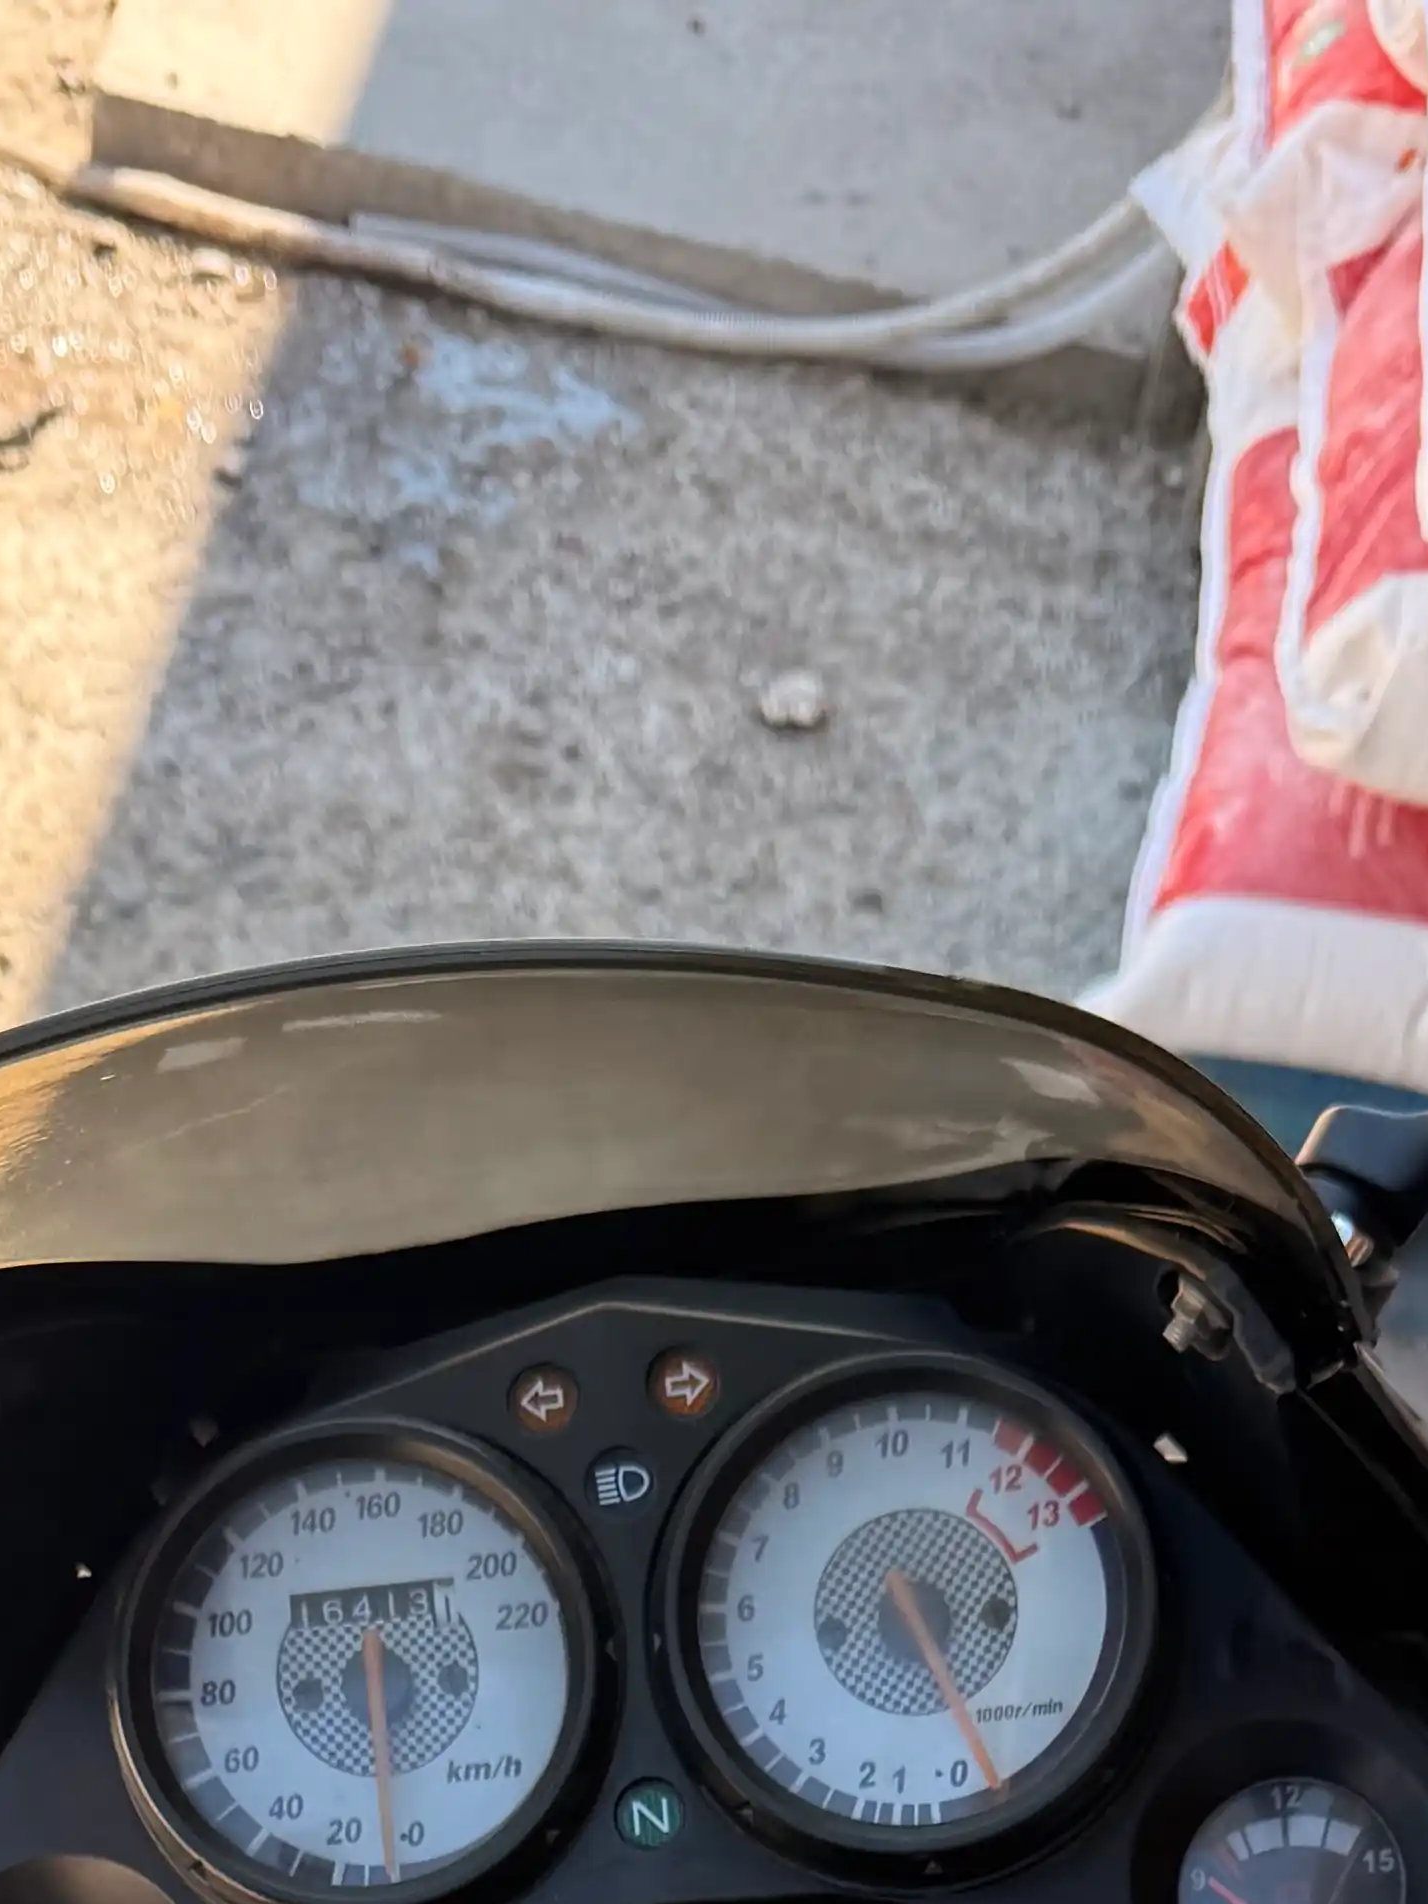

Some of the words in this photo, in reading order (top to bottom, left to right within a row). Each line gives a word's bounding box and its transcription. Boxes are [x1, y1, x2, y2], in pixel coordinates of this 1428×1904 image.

[875, 1431, 908, 1457] 10
[942, 1441, 971, 1467] 11
[827, 1451, 843, 1476] 9
[990, 1465, 1021, 1492] 12
[356, 1493, 401, 1520] 160
[783, 1484, 800, 1509] 8
[291, 1508, 336, 1535] 140
[418, 1510, 464, 1538] 180
[1027, 1501, 1060, 1529] 13
[753, 1536, 769, 1562] 7
[240, 1551, 283, 1579] 120
[467, 1552, 517, 1580] 200
[497, 1604, 548, 1631] 220
[738, 1596, 755, 1621] 6
[209, 1611, 252, 1637] 100
[747, 1655, 763, 1680] 5
[201, 1682, 236, 1705] 80
[769, 1698, 786, 1725] 4
[976, 1697, 1064, 1724] 1000r/min
[224, 1747, 259, 1772] 60
[809, 1739, 825, 1764] 3
[447, 1757, 522, 1783] km/h
[859, 1762, 876, 1787] 2
[893, 1766, 906, 1792] 1
[950, 1760, 968, 1786] 0
[269, 1796, 303, 1820] 40
[1271, 1786, 1302, 1810] 12
[631, 1799, 669, 1835] N
[327, 1822, 361, 1845] 20
[408, 1823, 423, 1846] 0
[1363, 1846, 1395, 1874] 15
[1190, 1867, 1206, 1892] 9
